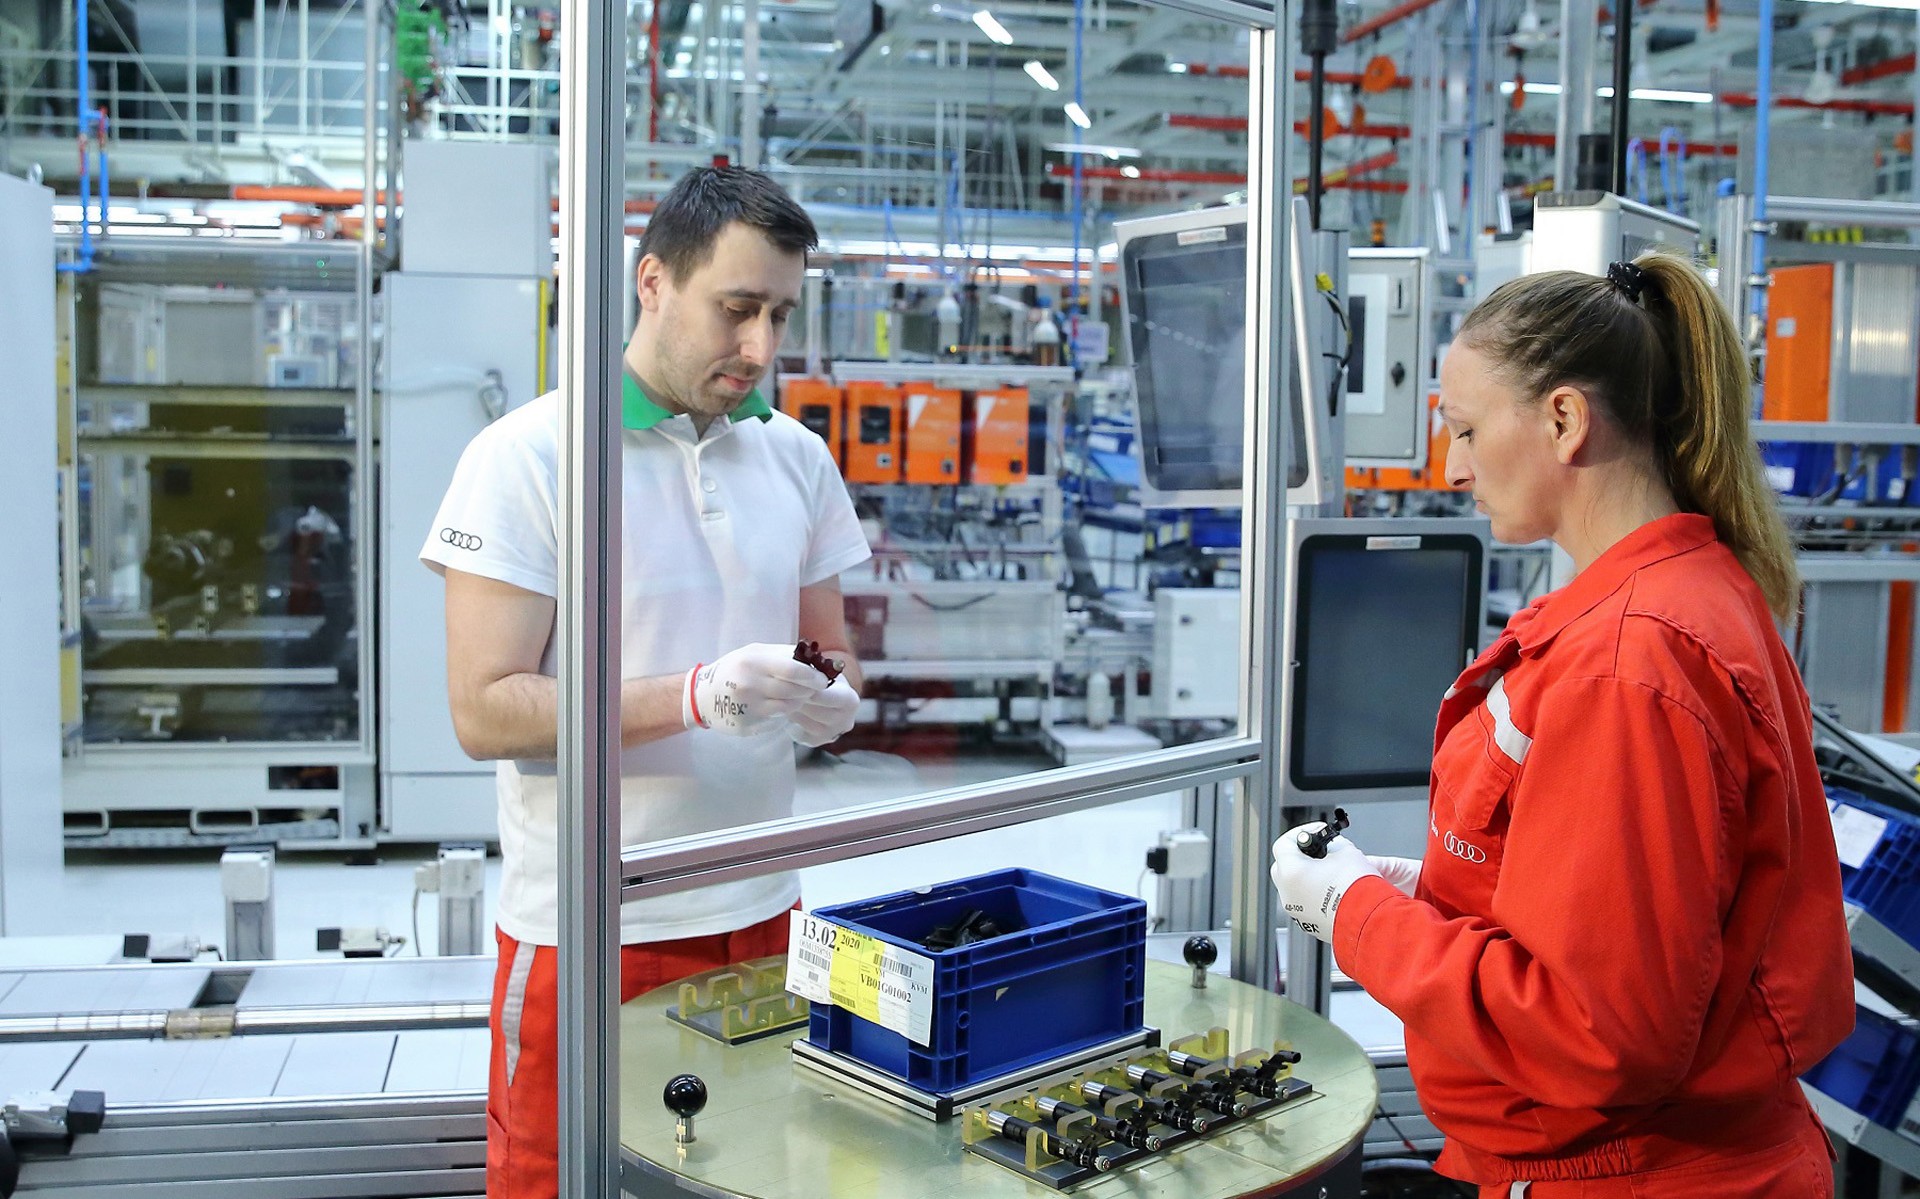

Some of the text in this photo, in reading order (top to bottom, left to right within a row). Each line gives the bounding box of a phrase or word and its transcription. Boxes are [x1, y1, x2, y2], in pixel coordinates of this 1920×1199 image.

[714, 694, 745, 718] HyFlex
[840, 934, 860, 950] 2020
[860, 973, 912, 1003] VB01G01002
[910, 982, 928, 994] KVM
